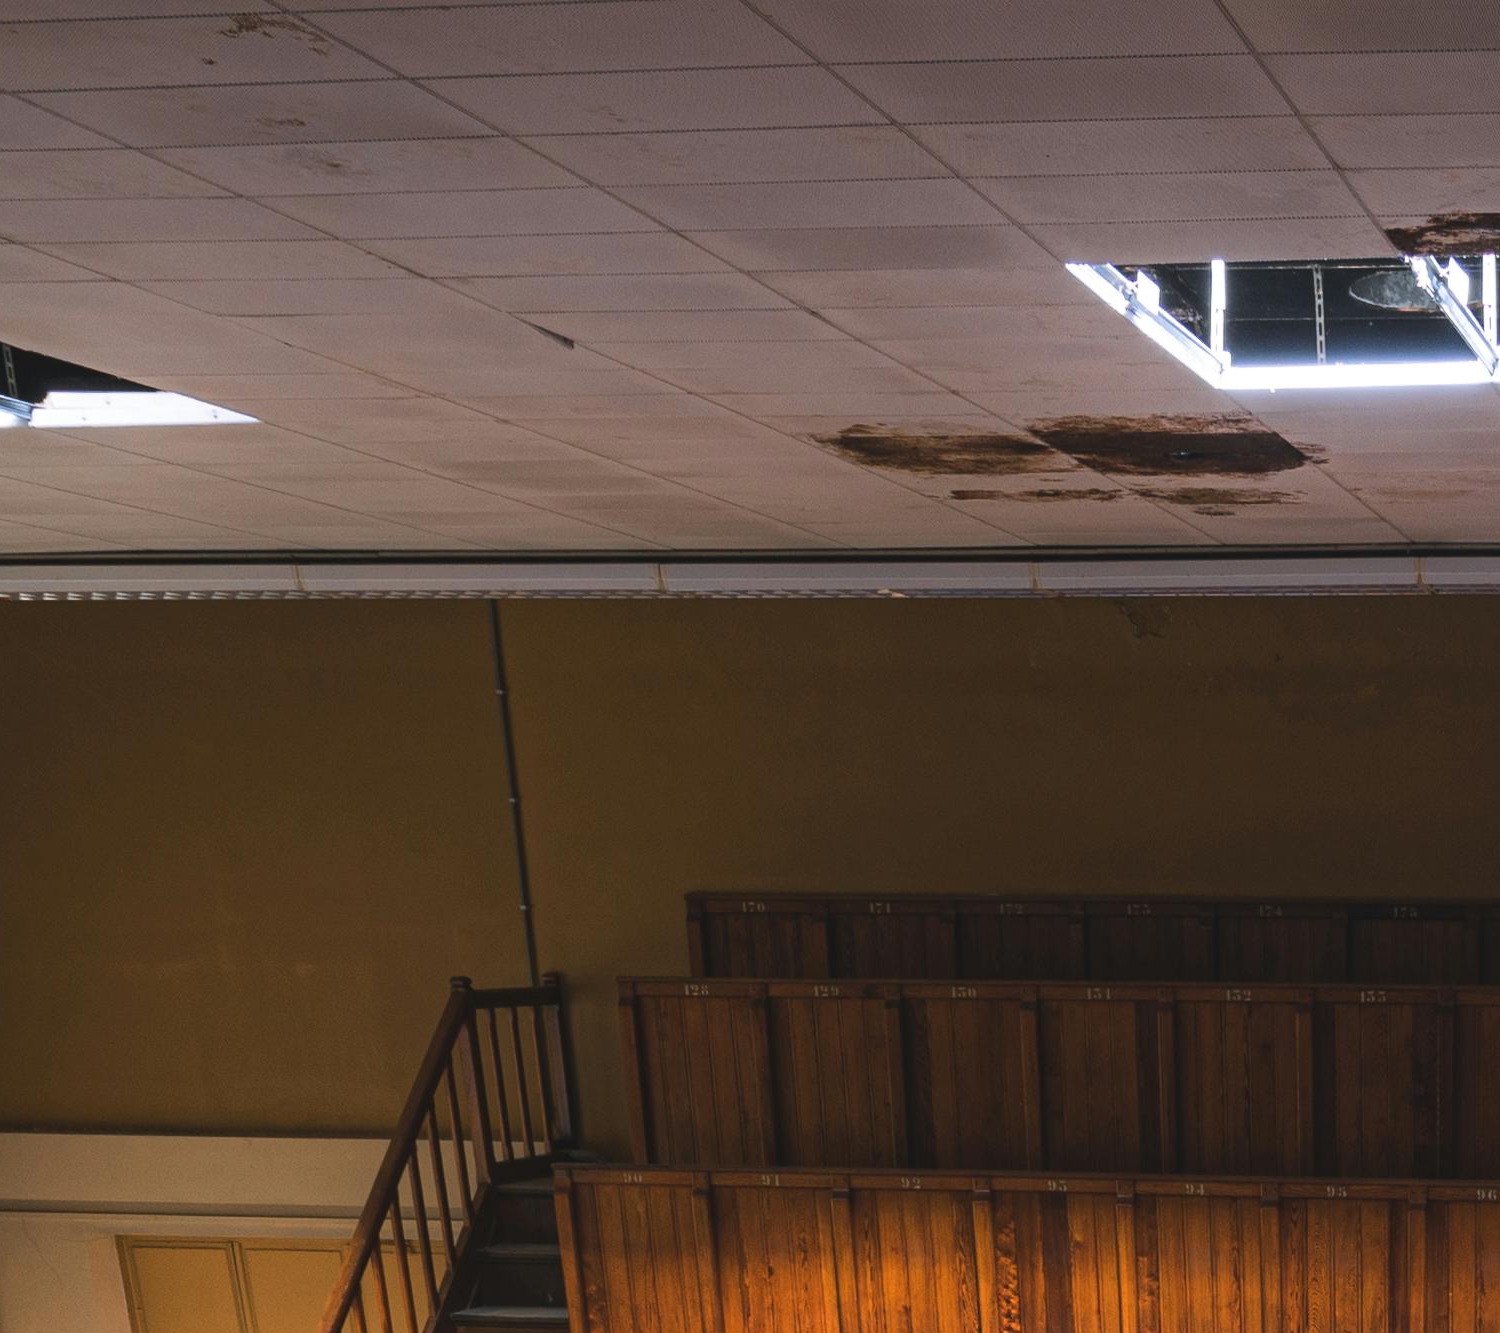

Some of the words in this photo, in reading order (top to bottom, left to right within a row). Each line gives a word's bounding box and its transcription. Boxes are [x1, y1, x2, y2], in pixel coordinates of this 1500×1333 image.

[742, 902, 765, 912] 170
[870, 903, 890, 914] 171
[1000, 904, 1023, 914] 172
[1260, 906, 1282, 916] 174
[685, 985, 709, 996] 128
[814, 985, 839, 996] 129
[952, 987, 976, 998] 130
[1087, 988, 1111, 999] 131
[1226, 989, 1252, 1001] 132
[1361, 990, 1386, 1002] 133
[762, 1175, 780, 1186] 91
[901, 1177, 921, 1189] 92
[1048, 1180, 1067, 1191] 93
[1186, 1184, 1204, 1195] 94
[1327, 1186, 1347, 1197] 95
[1477, 1189, 1497, 1200] 96
